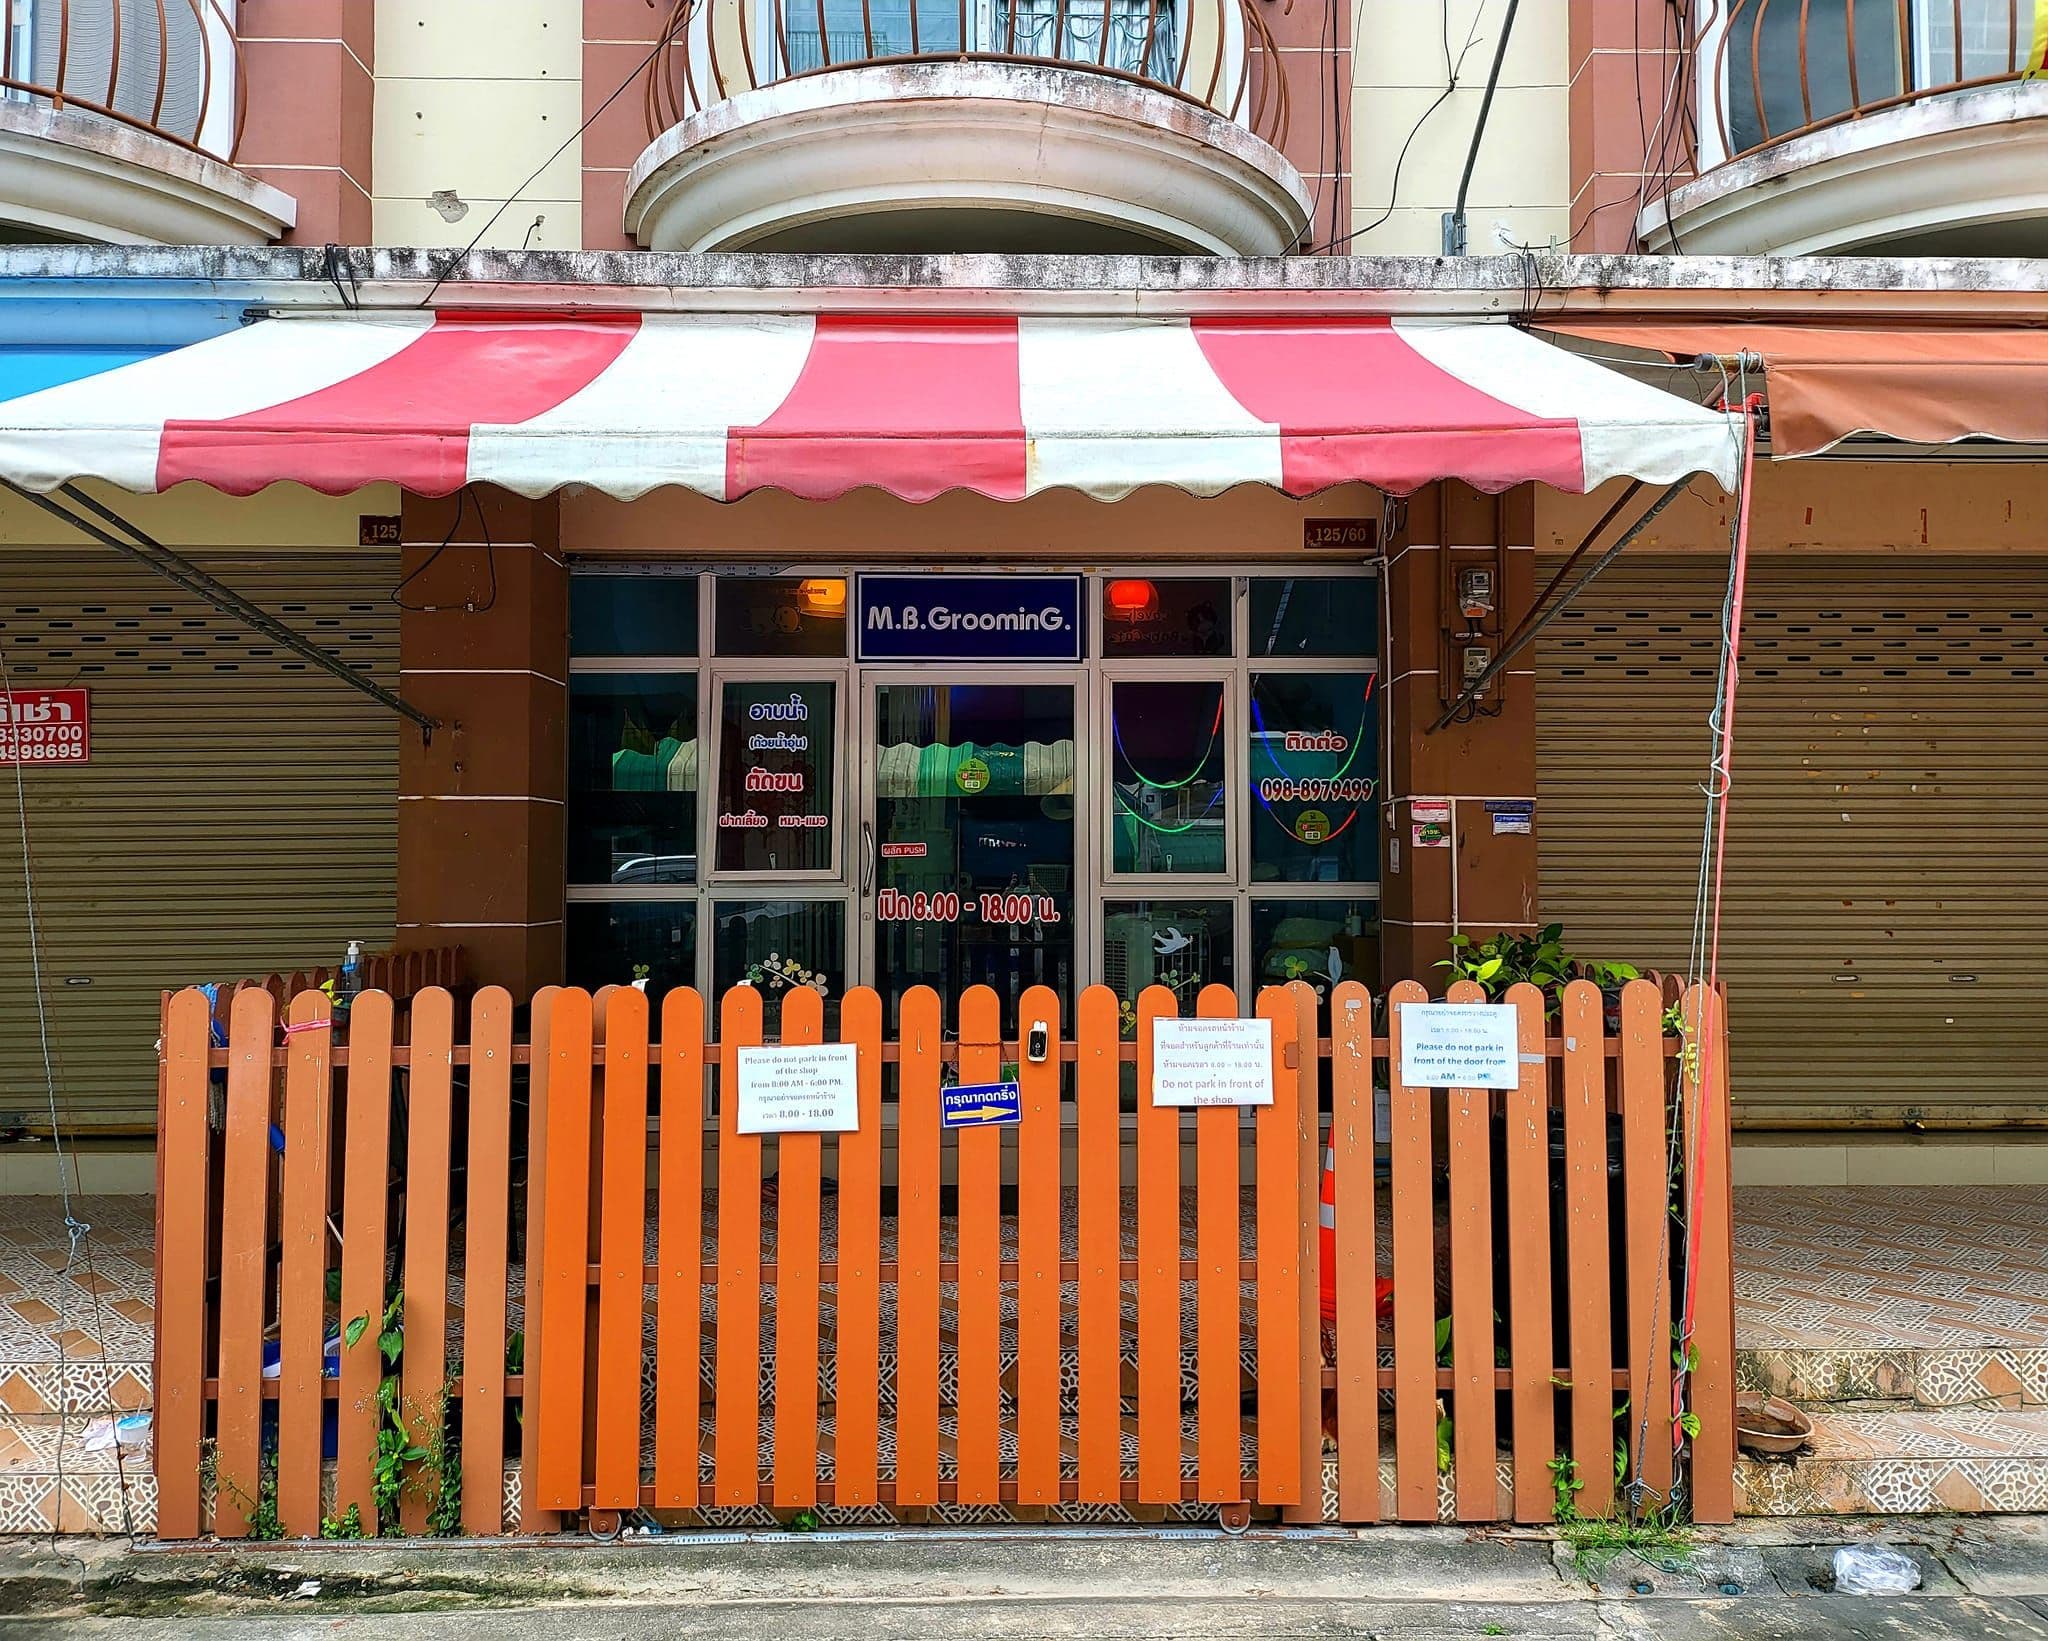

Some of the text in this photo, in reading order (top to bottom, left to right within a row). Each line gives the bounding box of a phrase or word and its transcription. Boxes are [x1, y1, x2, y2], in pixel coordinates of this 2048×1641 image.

[1316, 527, 1367, 544] 125/60
[867, 606, 1071, 631] M.B.GroominG.
[749, 693, 808, 721] อาบน้ำ
[749, 732, 808, 752] (ด้วยน้ำอุ่น)
[1285, 730, 1348, 752] ติดต่อ
[746, 766, 803, 791] ตัดขน
[1260, 778, 1373, 801] 098-8979499
[720, 809, 828, 827] ฝากเลี้ยง หมา-แมว
[883, 845, 925, 856] ผลัก PUSH
[963, 902, 976, 911] -
[1039, 897, 1061, 922] น.
[1416, 1043, 1443, 1051] Please
[1445, 1043, 1457, 1051] do
[1474, 1043, 1494, 1053] park
[1495, 1044, 1504, 1052] in
[745, 1054, 848, 1065] Please do not park in front
[1413, 1056, 1435, 1065] front
[1436, 1056, 1446, 1065] of
[1447, 1057, 1462, 1065] the
[1464, 1057, 1484, 1066] door
[775, 1066, 818, 1076] of the shop
[751, 1080, 770, 1089] from
[790, 1079, 804, 1087] AM
[810, 1078, 828, 1087] 6:00
[1162, 1079, 1265, 1090] Do not park in front of
[945, 1085, 1017, 1107] กรุณากดกริ่ง
[1193, 1096, 1209, 1104] the
[808, 1108, 834, 1118] 18.00
